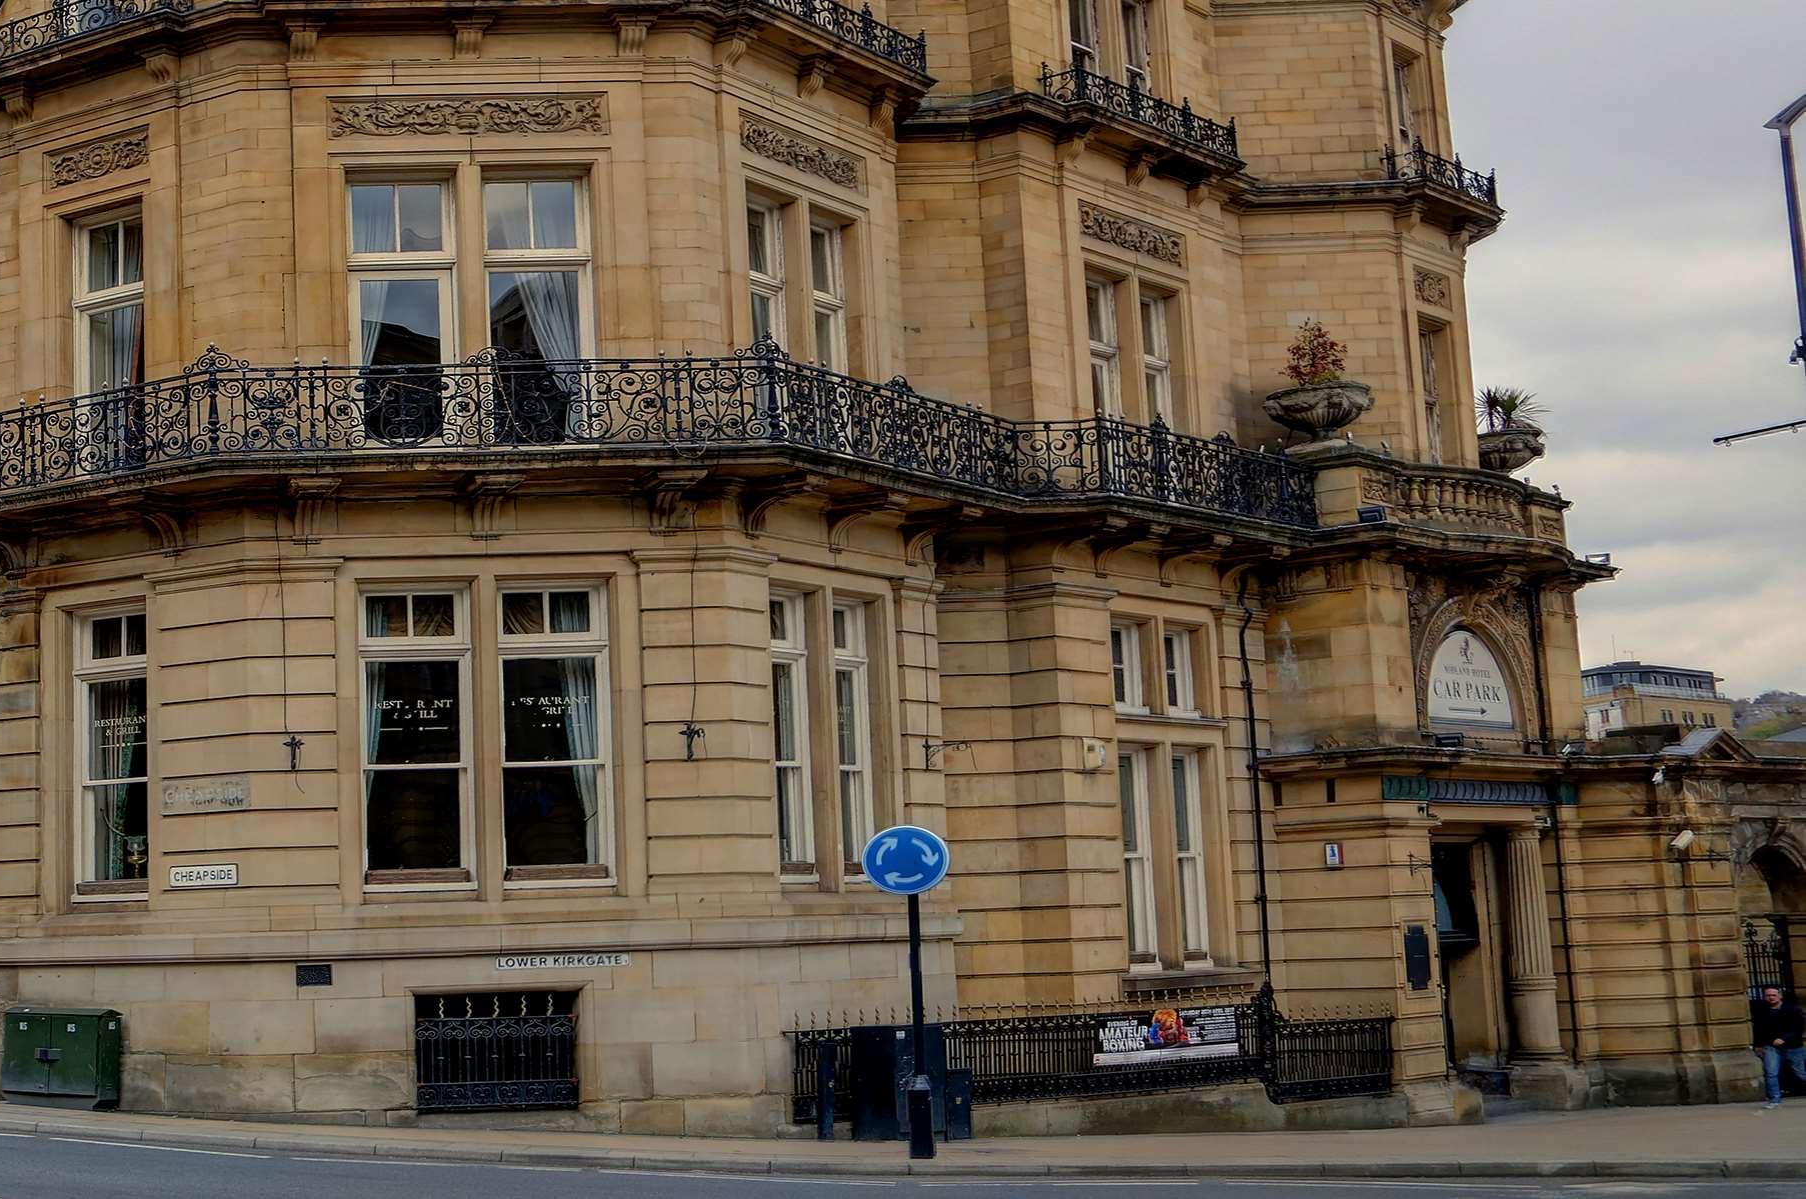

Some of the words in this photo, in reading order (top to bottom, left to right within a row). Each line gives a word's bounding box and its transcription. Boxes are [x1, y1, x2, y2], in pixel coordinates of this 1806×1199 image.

[1472, 667, 1491, 678] HOTEL
[1432, 679, 1462, 699] CAR
[1465, 682, 1501, 703] PARK
[94, 715, 147, 728] RESTAURAN
[106, 729, 113, 737] &
[115, 726, 142, 736] GRILL
[174, 869, 233, 882] CHEAPSIDE
[497, 956, 548, 968] LOWER
[1098, 1025, 1148, 1042] AMATEUR
[1102, 1038, 1145, 1052] BOXING
